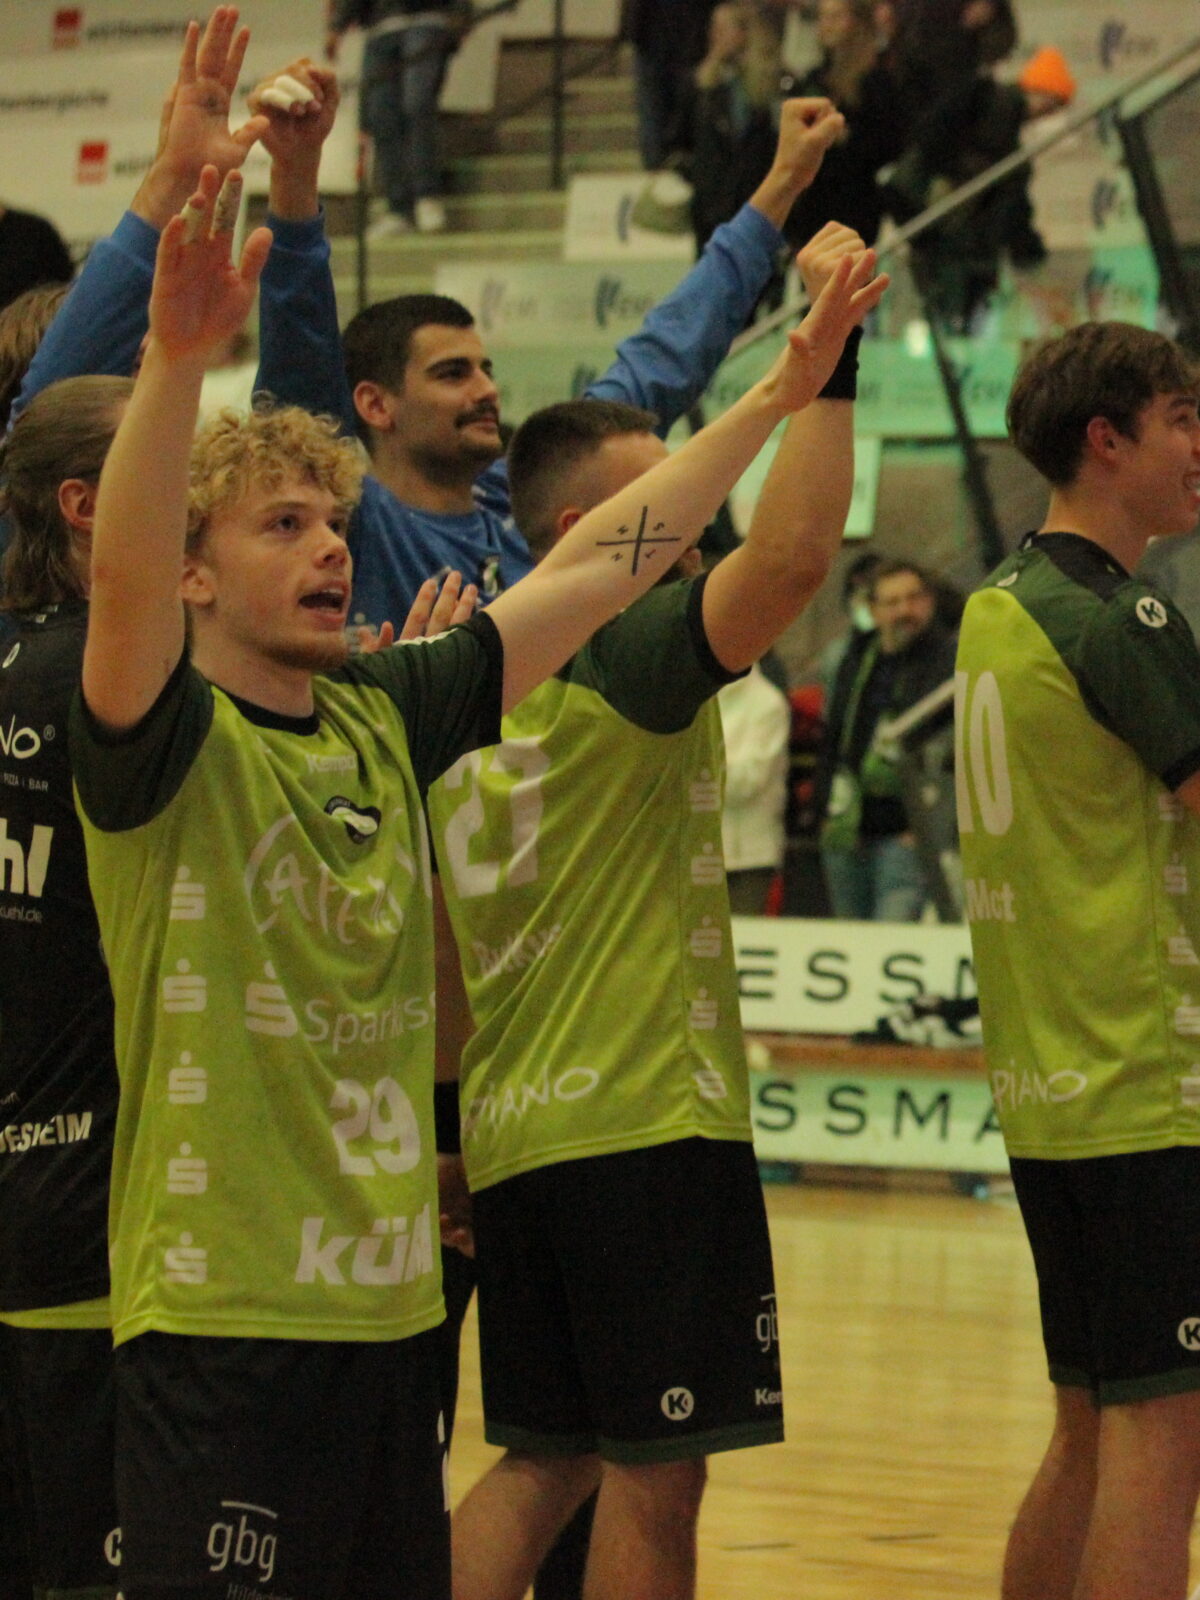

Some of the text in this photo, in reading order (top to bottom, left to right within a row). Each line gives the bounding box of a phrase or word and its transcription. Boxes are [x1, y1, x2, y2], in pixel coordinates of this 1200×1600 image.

[444, 735, 552, 898] 27
[954, 670, 1014, 836] 10
[329, 1076, 421, 1176] 29
[206, 1514, 278, 1583] gbg
